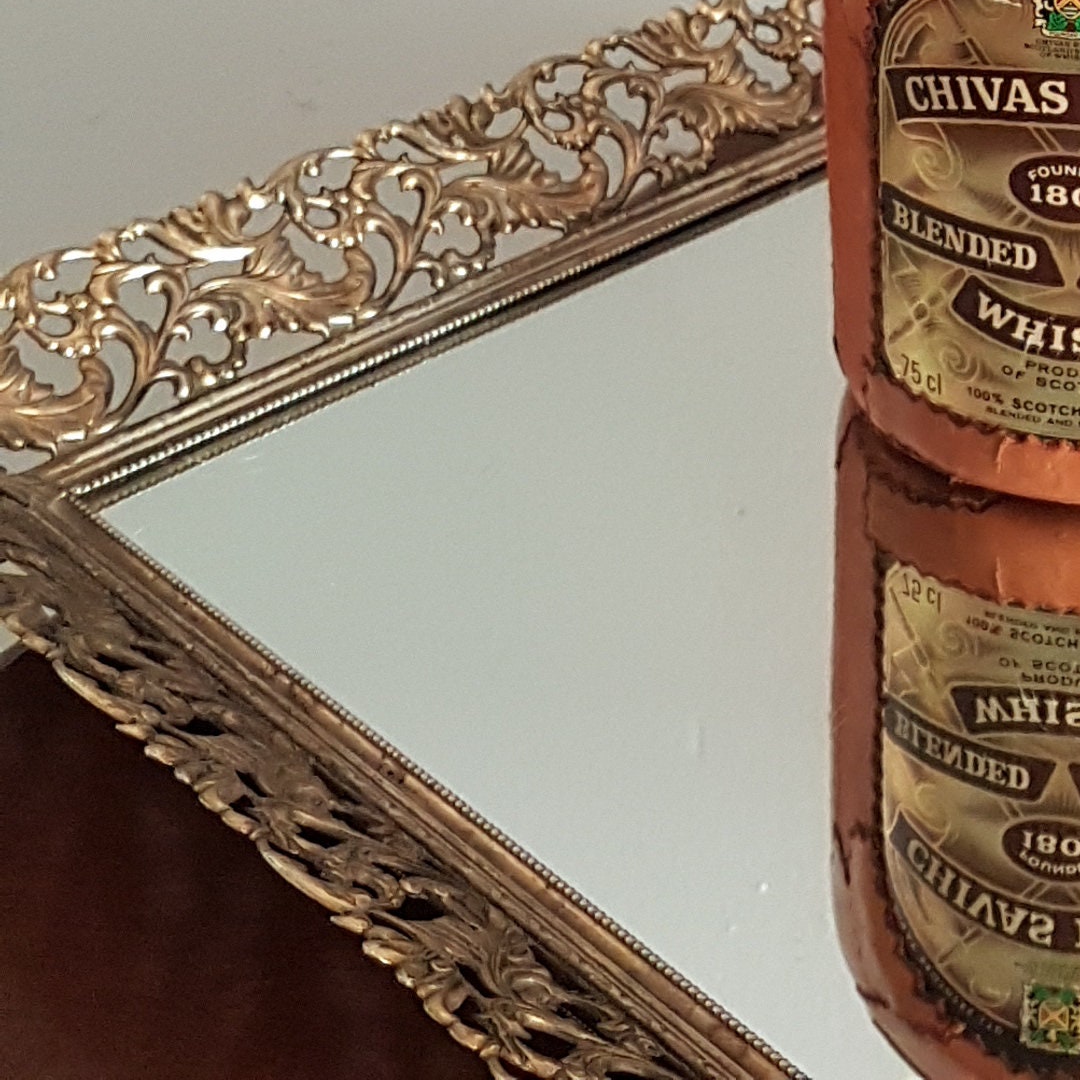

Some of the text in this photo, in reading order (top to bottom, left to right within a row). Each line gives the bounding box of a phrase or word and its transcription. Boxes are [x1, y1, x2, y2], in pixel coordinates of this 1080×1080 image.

[905, 75, 1069, 116] CHIVAS
[892, 200, 1038, 272] BLENDED
[901, 353, 921, 385] 75
[1002, 365, 1025, 379] OF
[967, 386, 1004, 405] 100%
